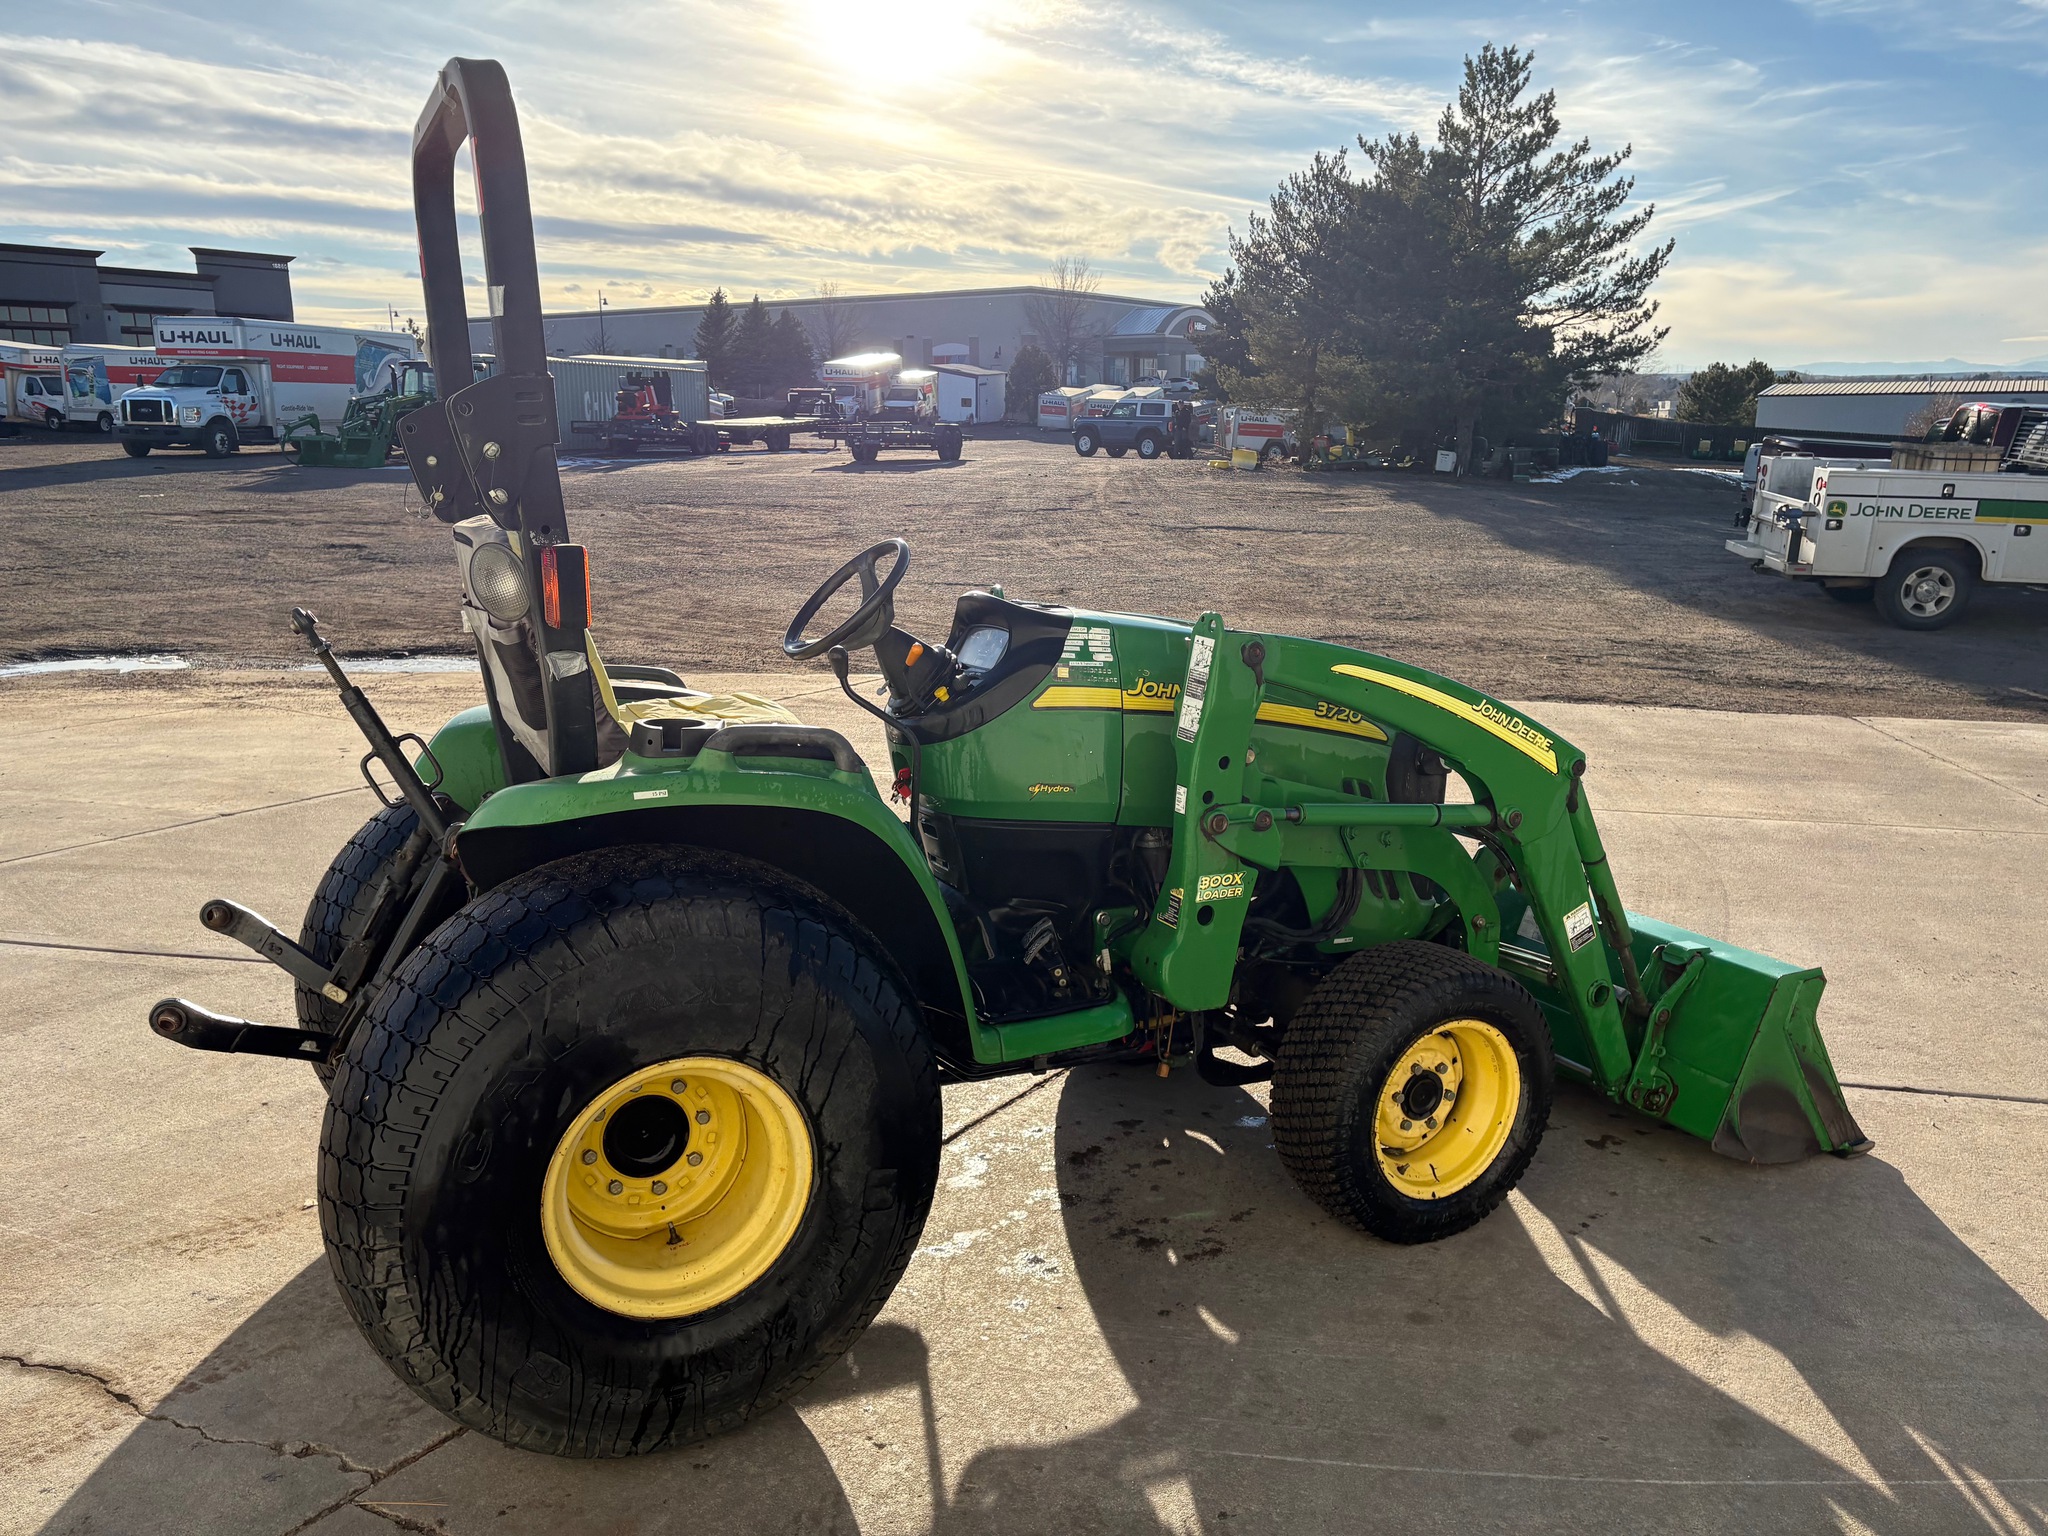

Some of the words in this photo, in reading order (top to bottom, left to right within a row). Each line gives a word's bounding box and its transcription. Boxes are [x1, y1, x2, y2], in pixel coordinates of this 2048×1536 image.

[159, 330, 233, 344] U-HAUL
[270, 333, 321, 349] U-HAUL
[33, 355, 60, 364] U-HA
[129, 356, 166, 366] U-HAUL
[825, 368, 859, 376] U-HAUL
[1241, 415, 1270, 423] U-HAUL
[1850, 502, 1904, 518] JOHN
[1908, 504, 1973, 520] DEERE
[1314, 701, 1363, 724] 3720
[1471, 699, 1511, 729] JOHN
[1508, 716, 1554, 752] DEERE
[1197, 887, 1243, 902] LOADER
